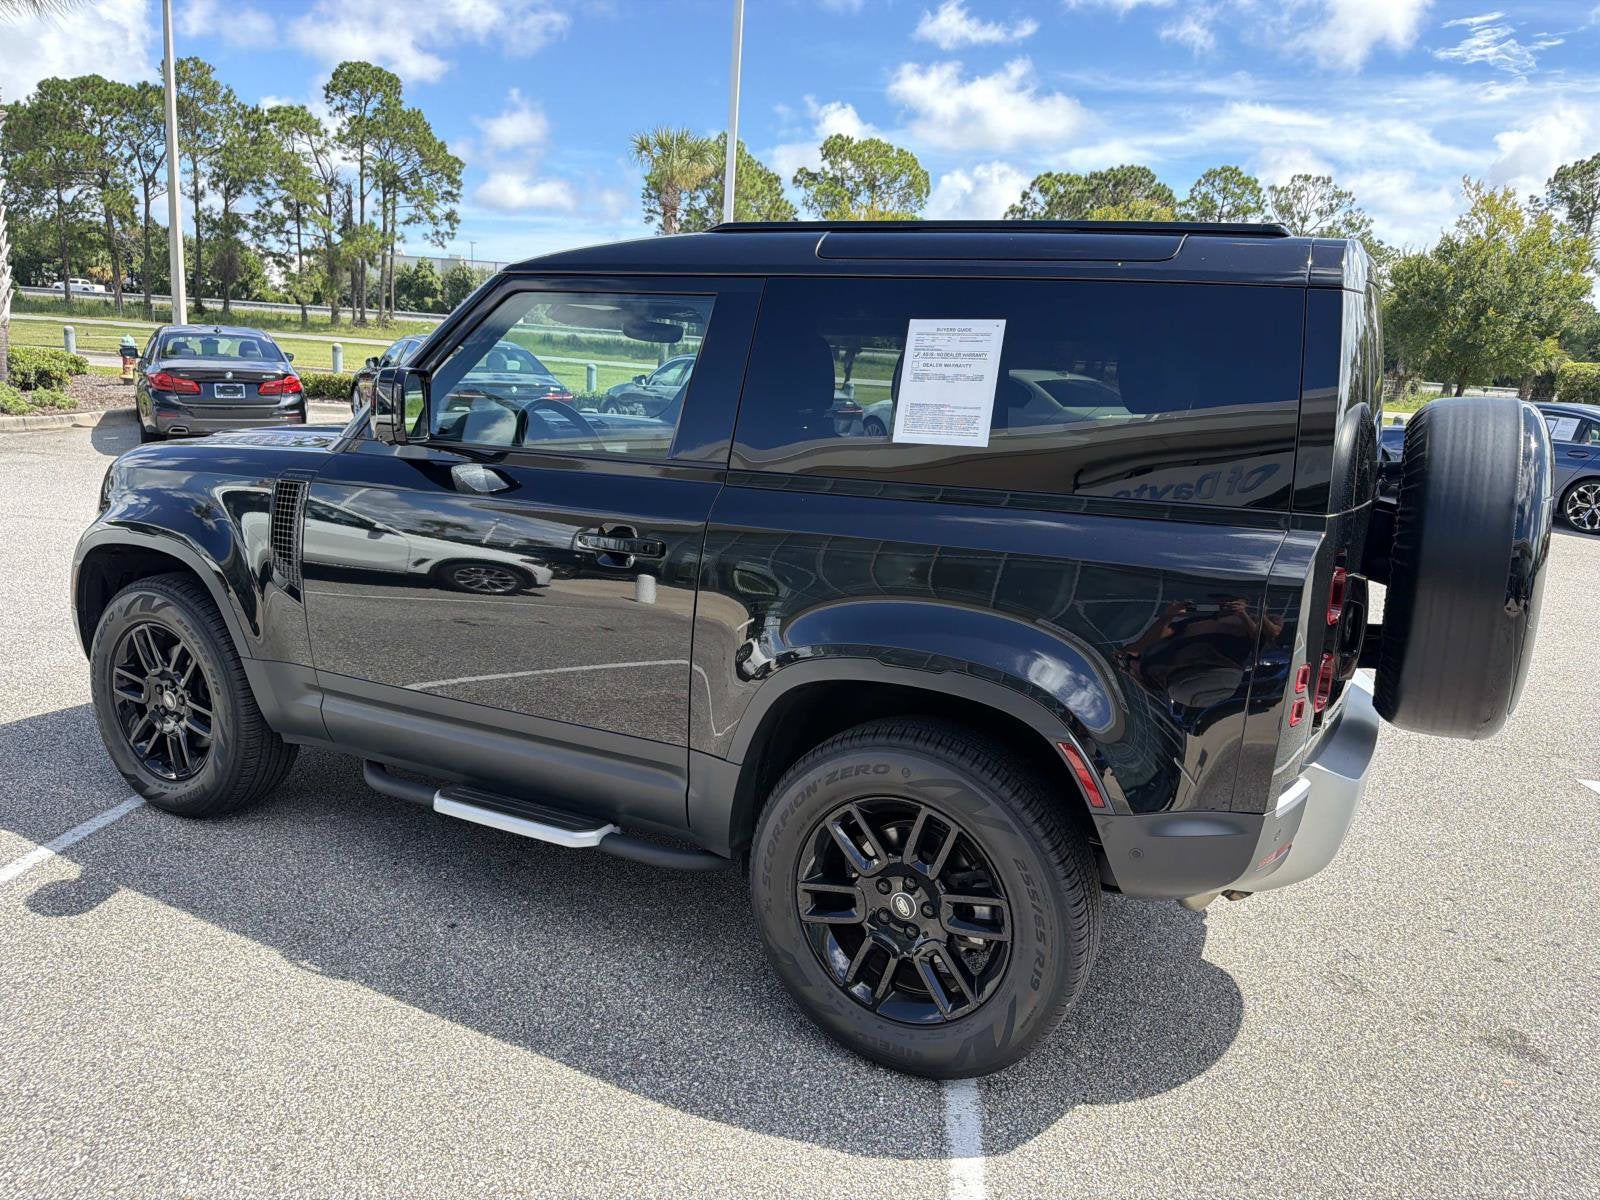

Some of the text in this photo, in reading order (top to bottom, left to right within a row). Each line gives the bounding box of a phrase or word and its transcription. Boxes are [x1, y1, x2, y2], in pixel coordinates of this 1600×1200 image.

[761, 763, 891, 887] SCORPION ZERO
[1012, 856, 1047, 992] 255/65 R19
